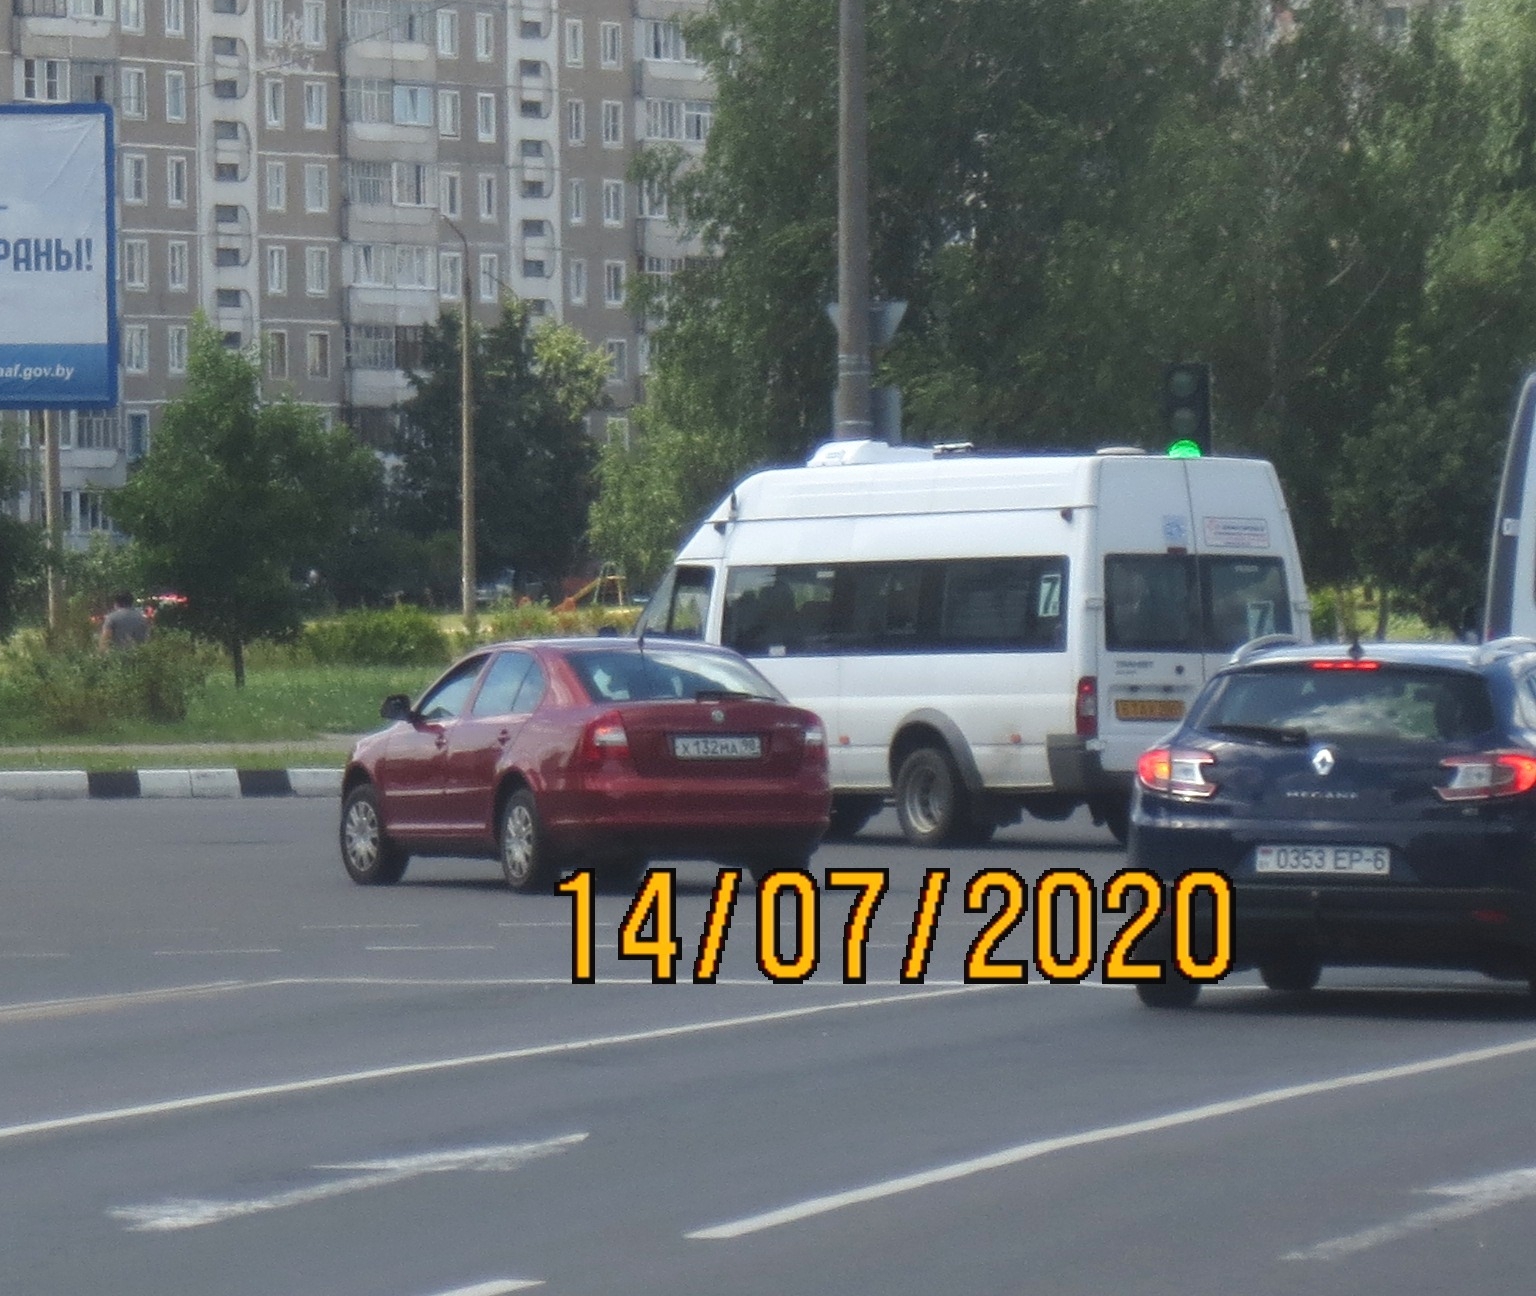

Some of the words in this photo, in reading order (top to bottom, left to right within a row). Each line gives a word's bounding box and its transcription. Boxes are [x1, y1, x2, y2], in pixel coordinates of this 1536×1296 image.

[1042, 576, 1059, 614] 7
[1276, 848, 1326, 869] 0353
[1333, 850, 1386, 870] EP-6
